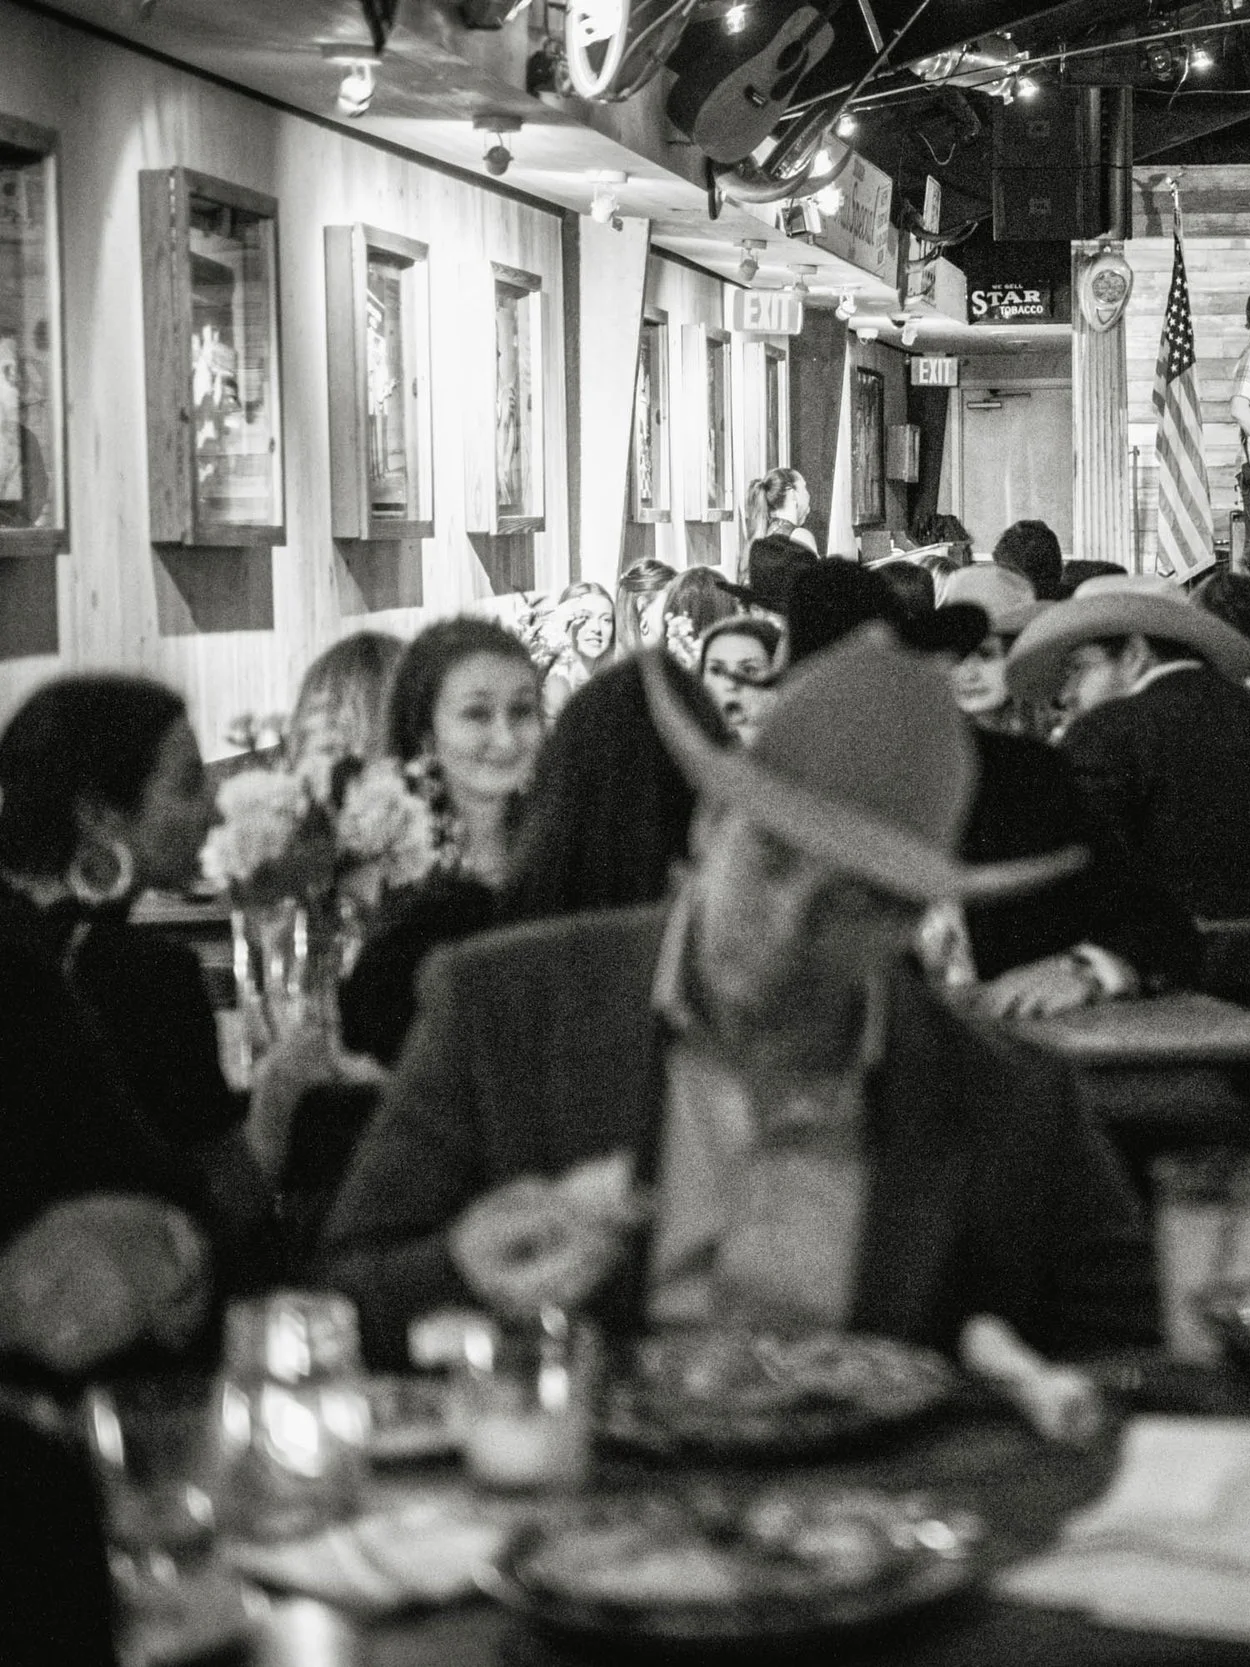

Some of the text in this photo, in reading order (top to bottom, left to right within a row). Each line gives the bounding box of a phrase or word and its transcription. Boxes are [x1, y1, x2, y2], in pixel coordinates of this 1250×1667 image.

[743, 292, 790, 330] EXIT
[971, 290, 1041, 315] STAR
[999, 304, 1044, 317] TOBACCO
[919, 358, 952, 384] EXIT
